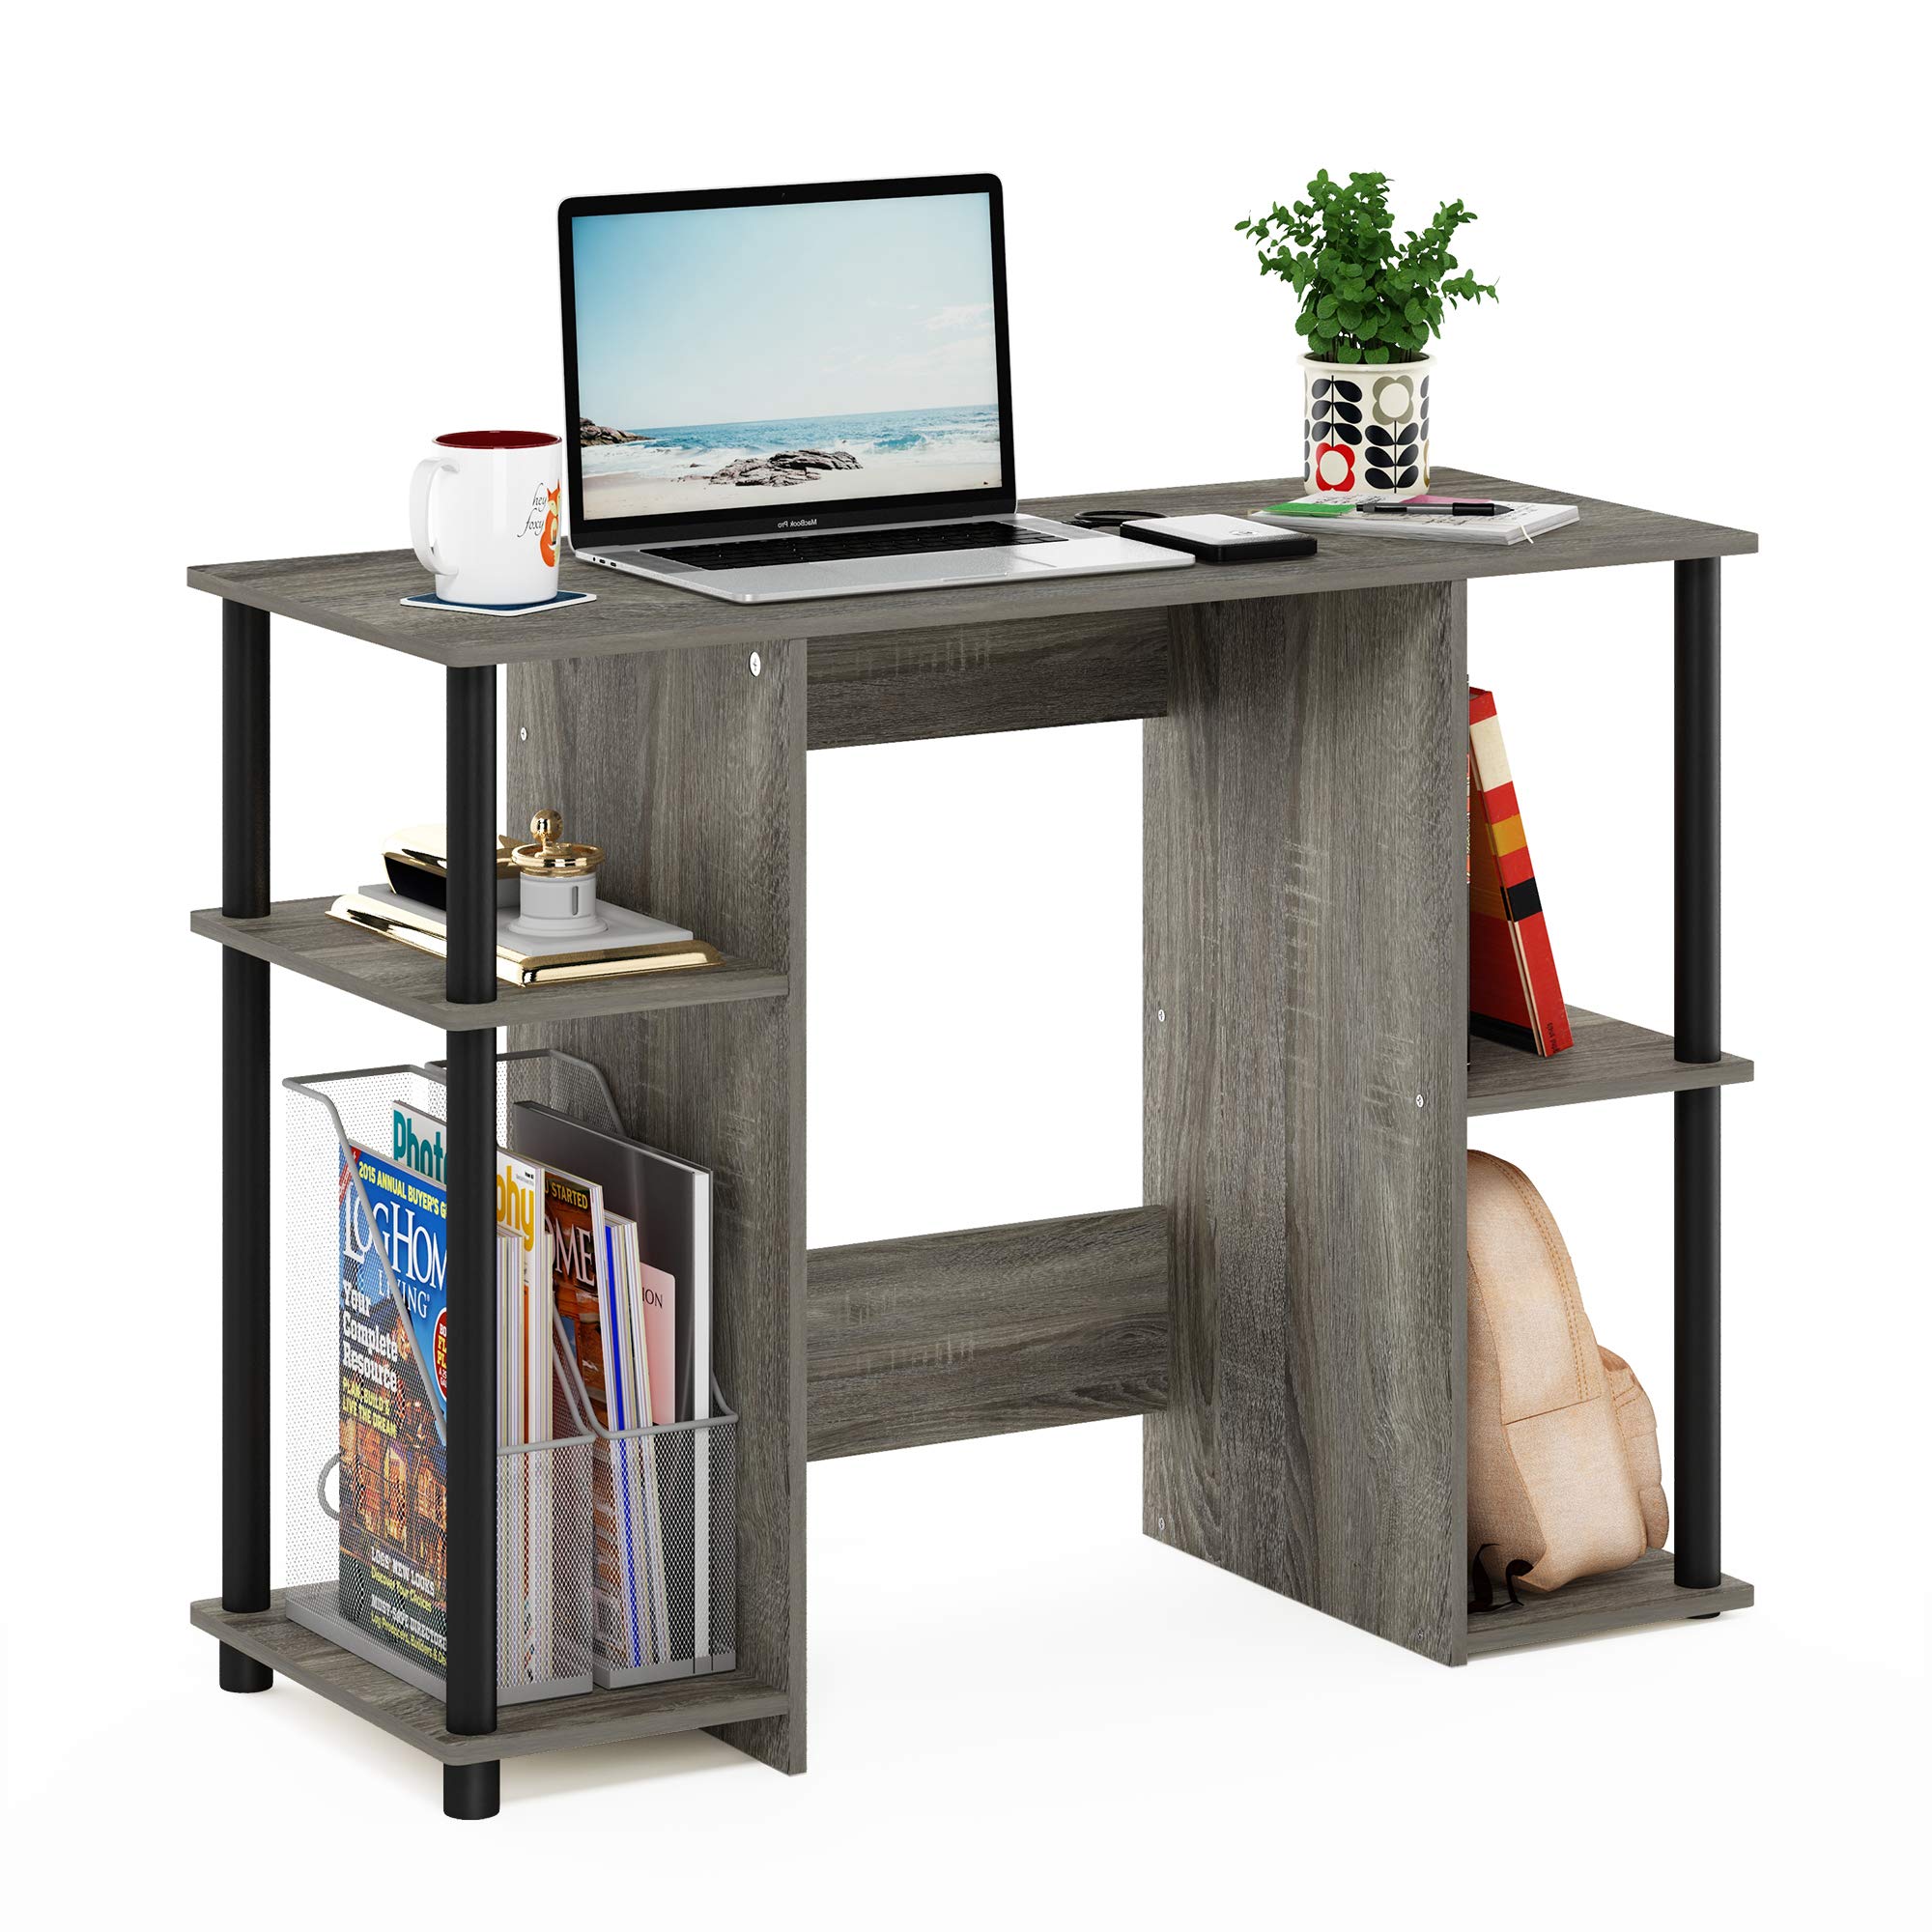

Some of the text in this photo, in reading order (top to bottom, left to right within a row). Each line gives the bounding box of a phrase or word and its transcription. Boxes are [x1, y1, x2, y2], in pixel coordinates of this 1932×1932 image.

[517, 507, 545, 538] foxy
[532, 482, 548, 513] hey
[393, 1109, 446, 1185] Phot
[358, 1160, 376, 1184] 2015
[377, 1170, 408, 1200] ANNUAL
[407, 1184, 440, 1215] BUYER'S
[551, 1181, 588, 1210] STARTED
[342, 1279, 372, 1319] Your
[378, 1268, 428, 1319] LIING
[342, 1309, 398, 1363] Complete
[342, 1339, 398, 1393] Resource
